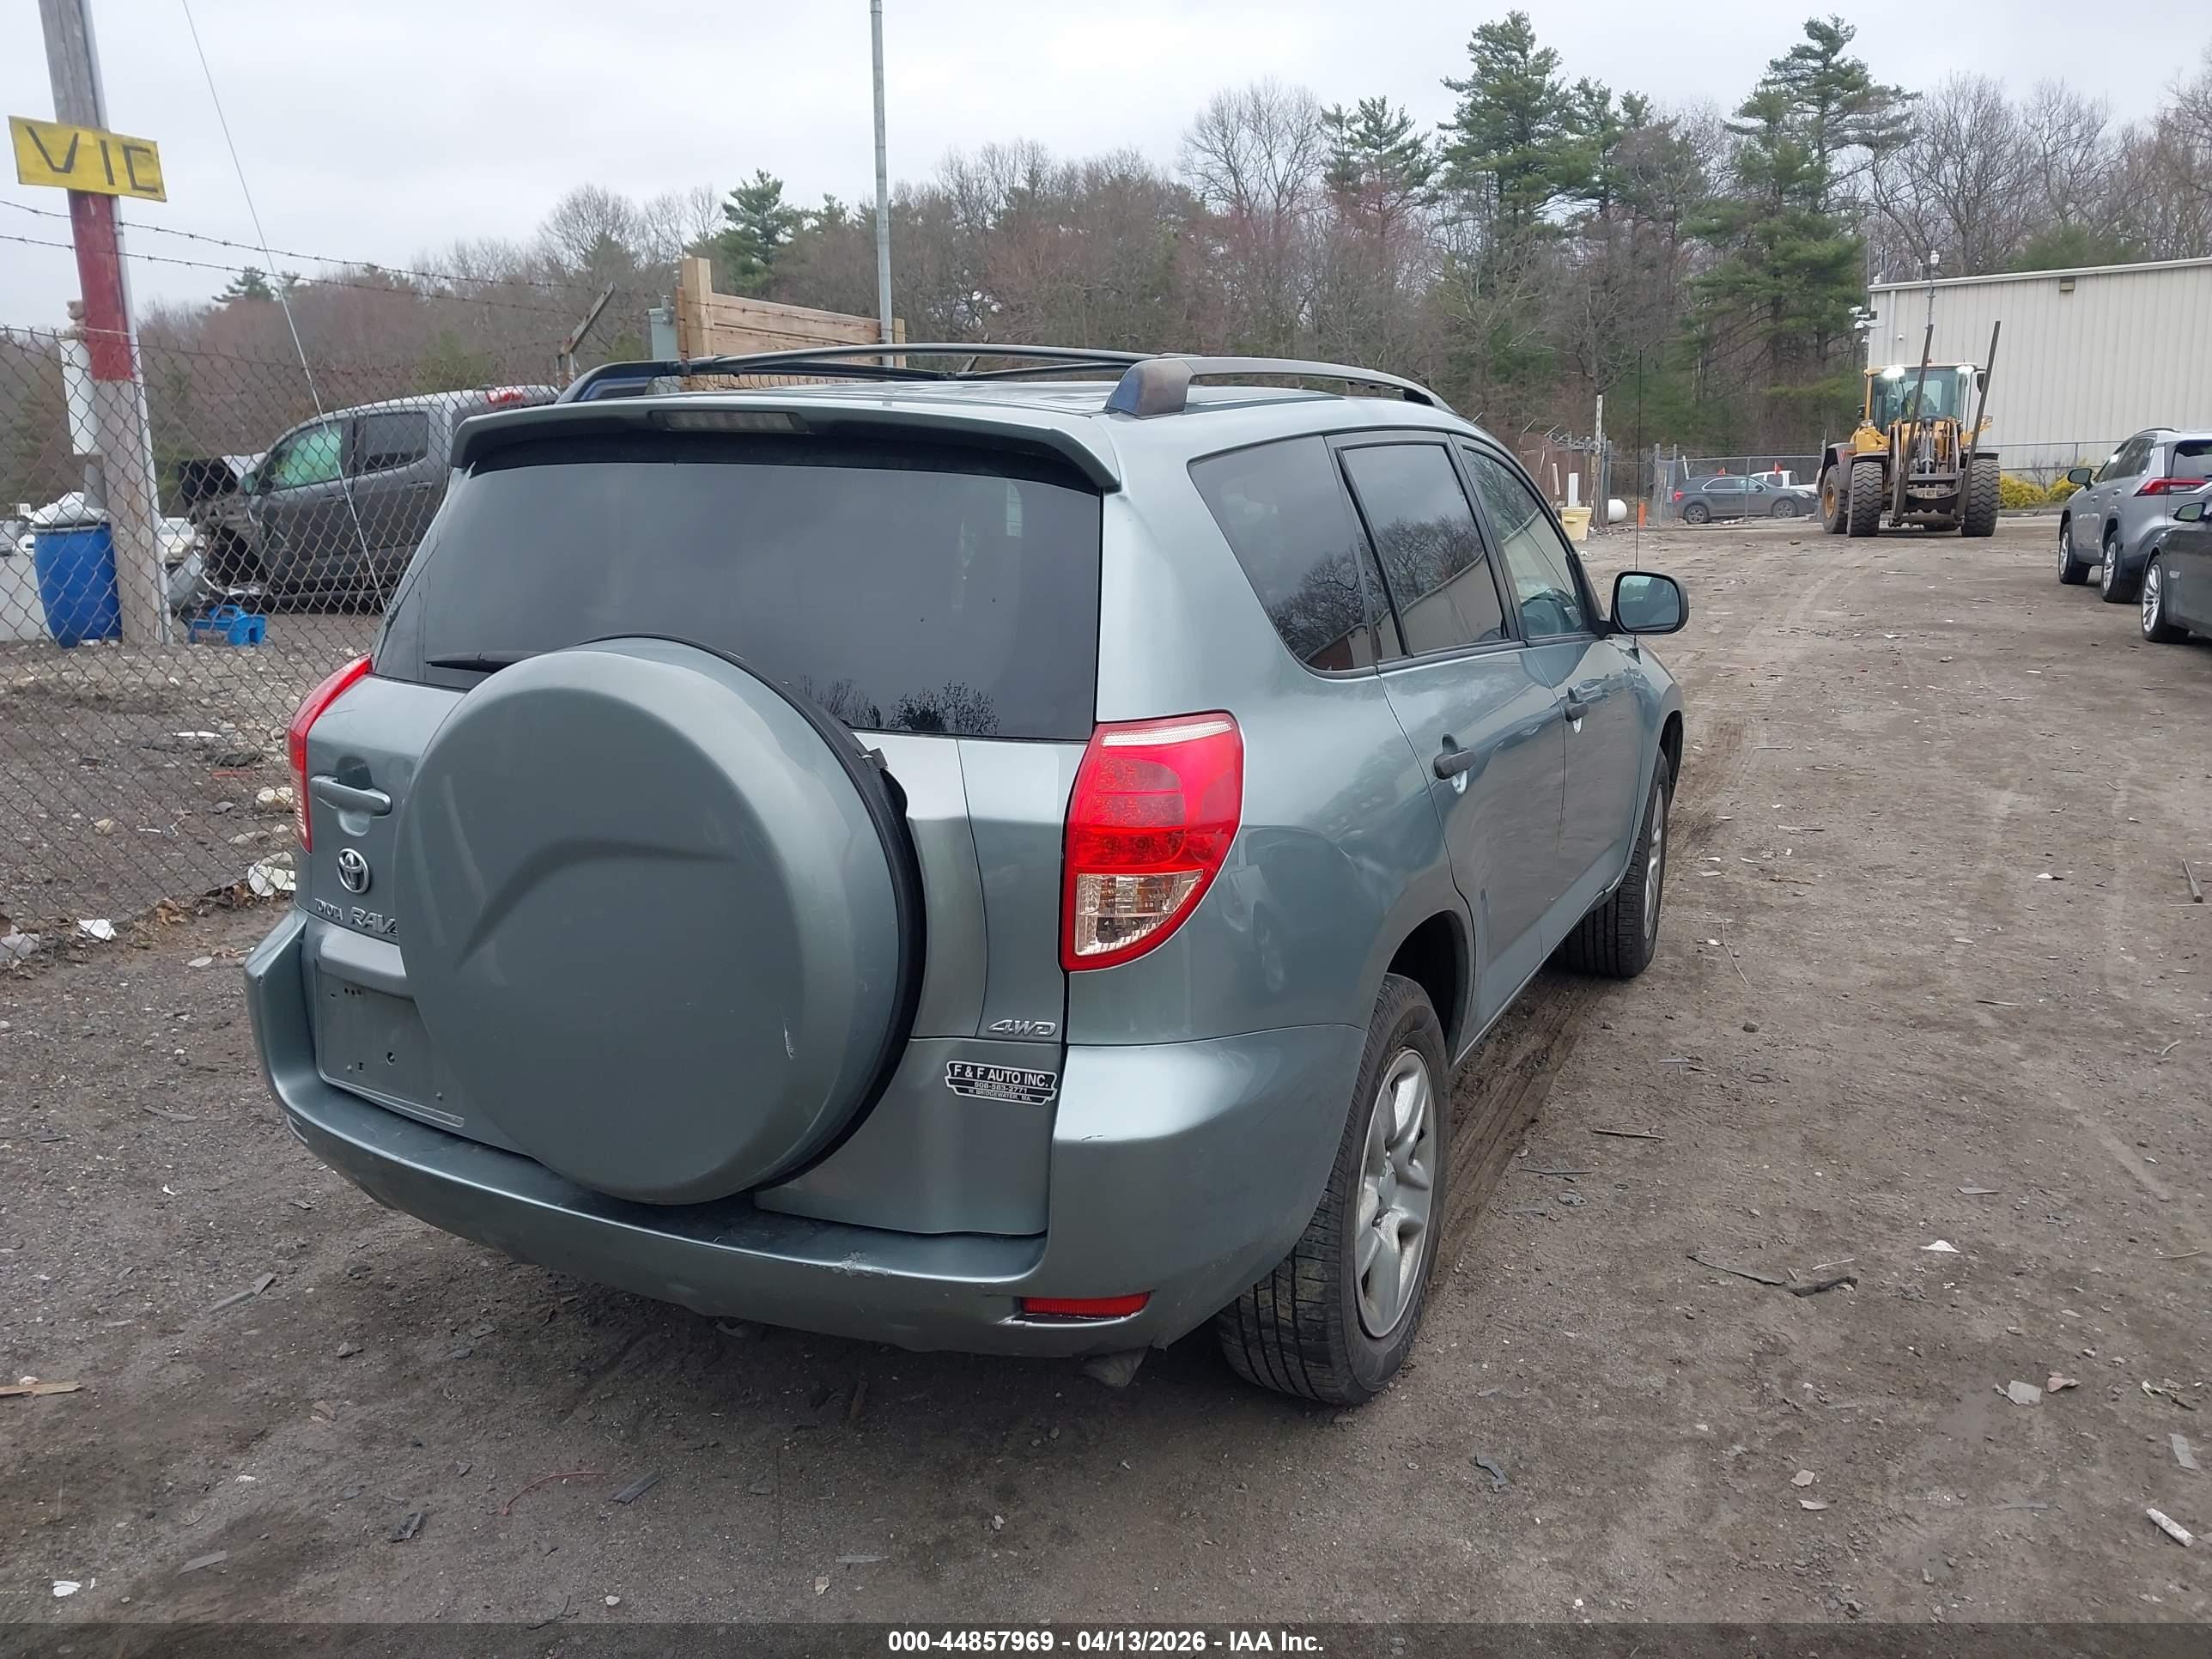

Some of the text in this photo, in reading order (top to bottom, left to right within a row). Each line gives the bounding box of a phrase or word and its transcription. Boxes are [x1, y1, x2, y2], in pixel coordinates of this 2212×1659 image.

[26, 125, 159, 193] VIC
[988, 1019, 1056, 1037] 4WD
[954, 1065, 1048, 1087] F & F AUTO INC.
